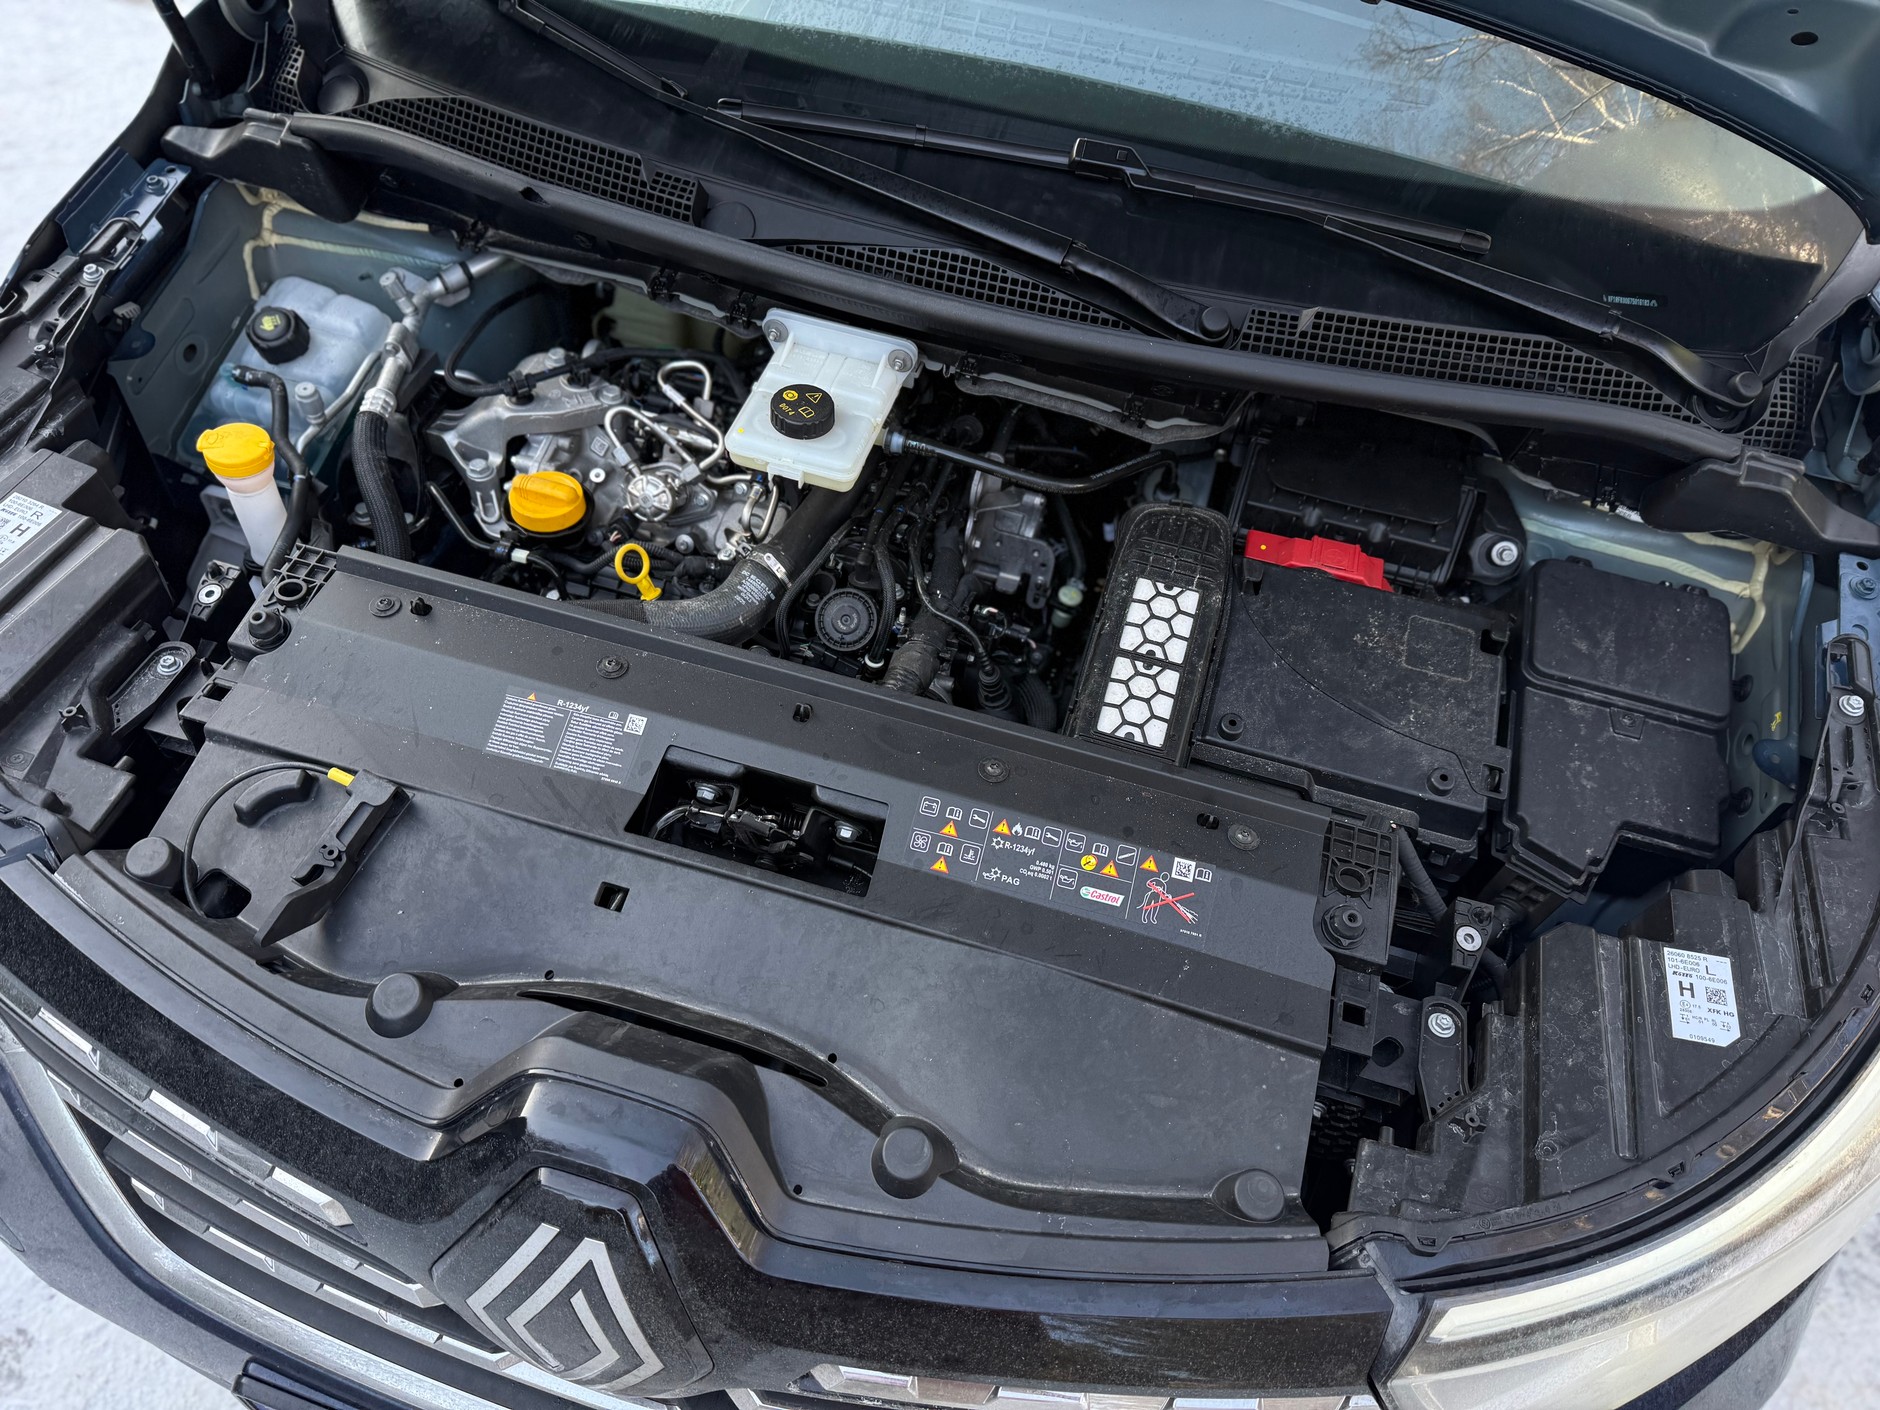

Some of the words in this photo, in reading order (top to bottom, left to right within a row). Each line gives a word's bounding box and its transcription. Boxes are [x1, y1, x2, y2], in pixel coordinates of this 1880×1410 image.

[30, 510, 44, 520] R
[10, 523, 31, 537] H
[557, 699, 590, 713] R-1234yf
[1004, 841, 1036, 856] R-1234yf
[1029, 864, 1041, 872] GWP
[1001, 874, 1020, 886] PAG
[1090, 889, 1121, 905] Castrol
[1666, 950, 1686, 959] 26060
[1667, 957, 1700, 967] 101-6E006
[1705, 964, 1717, 976] L
[1695, 974, 1728, 985] 100-6E006
[1678, 980, 1695, 999] H
[1707, 1007, 1721, 1015] XFK
[1723, 1010, 1735, 1018] HG
